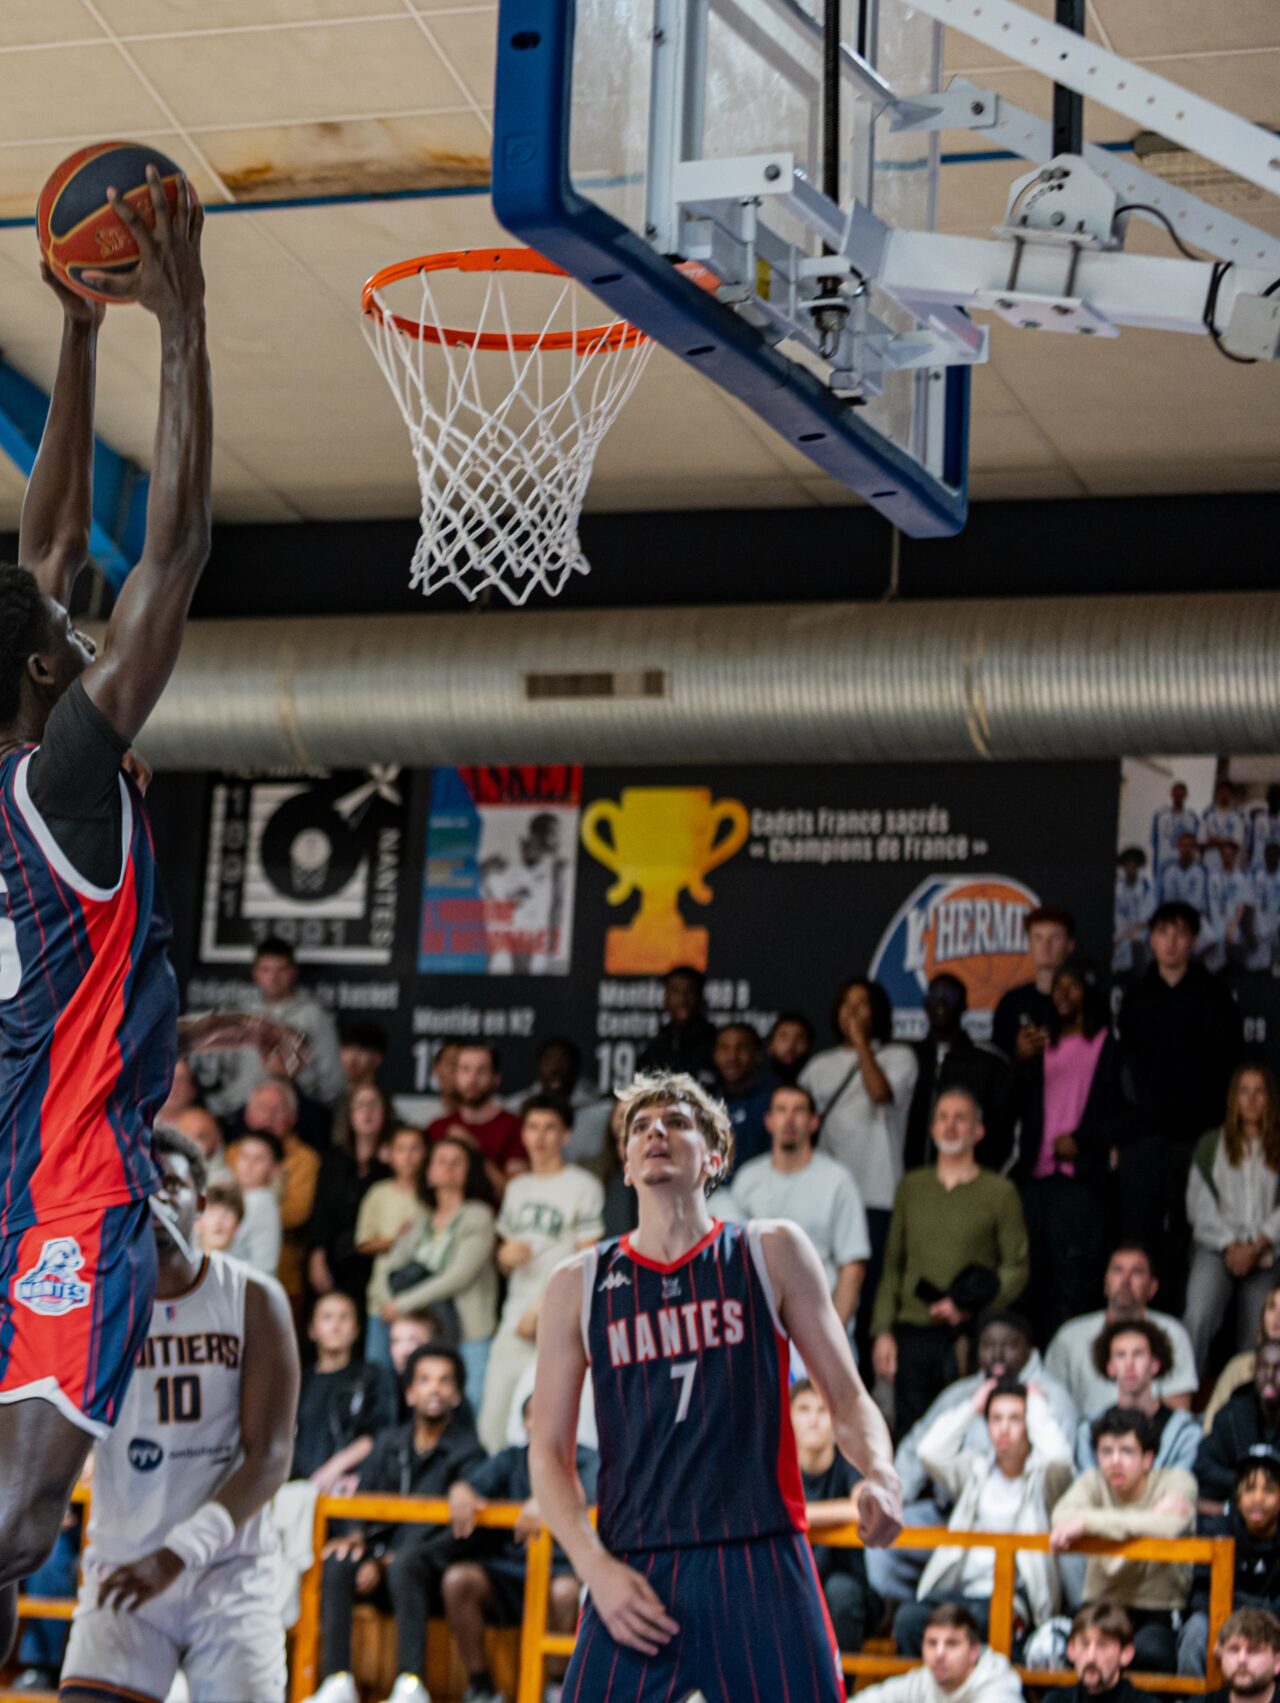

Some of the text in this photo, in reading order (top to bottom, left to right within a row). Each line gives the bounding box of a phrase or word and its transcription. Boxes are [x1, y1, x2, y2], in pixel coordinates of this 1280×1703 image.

[752, 804, 948, 835] Cadets France sacrés
[769, 837, 872, 863] Champions
[875, 835, 900, 861] de
[904, 834, 968, 861] France
[372, 828, 400, 947] NANTES
[607, 1299, 745, 1368] NANTES
[155, 1375, 202, 1425] 10
[670, 1361, 698, 1424] 7
